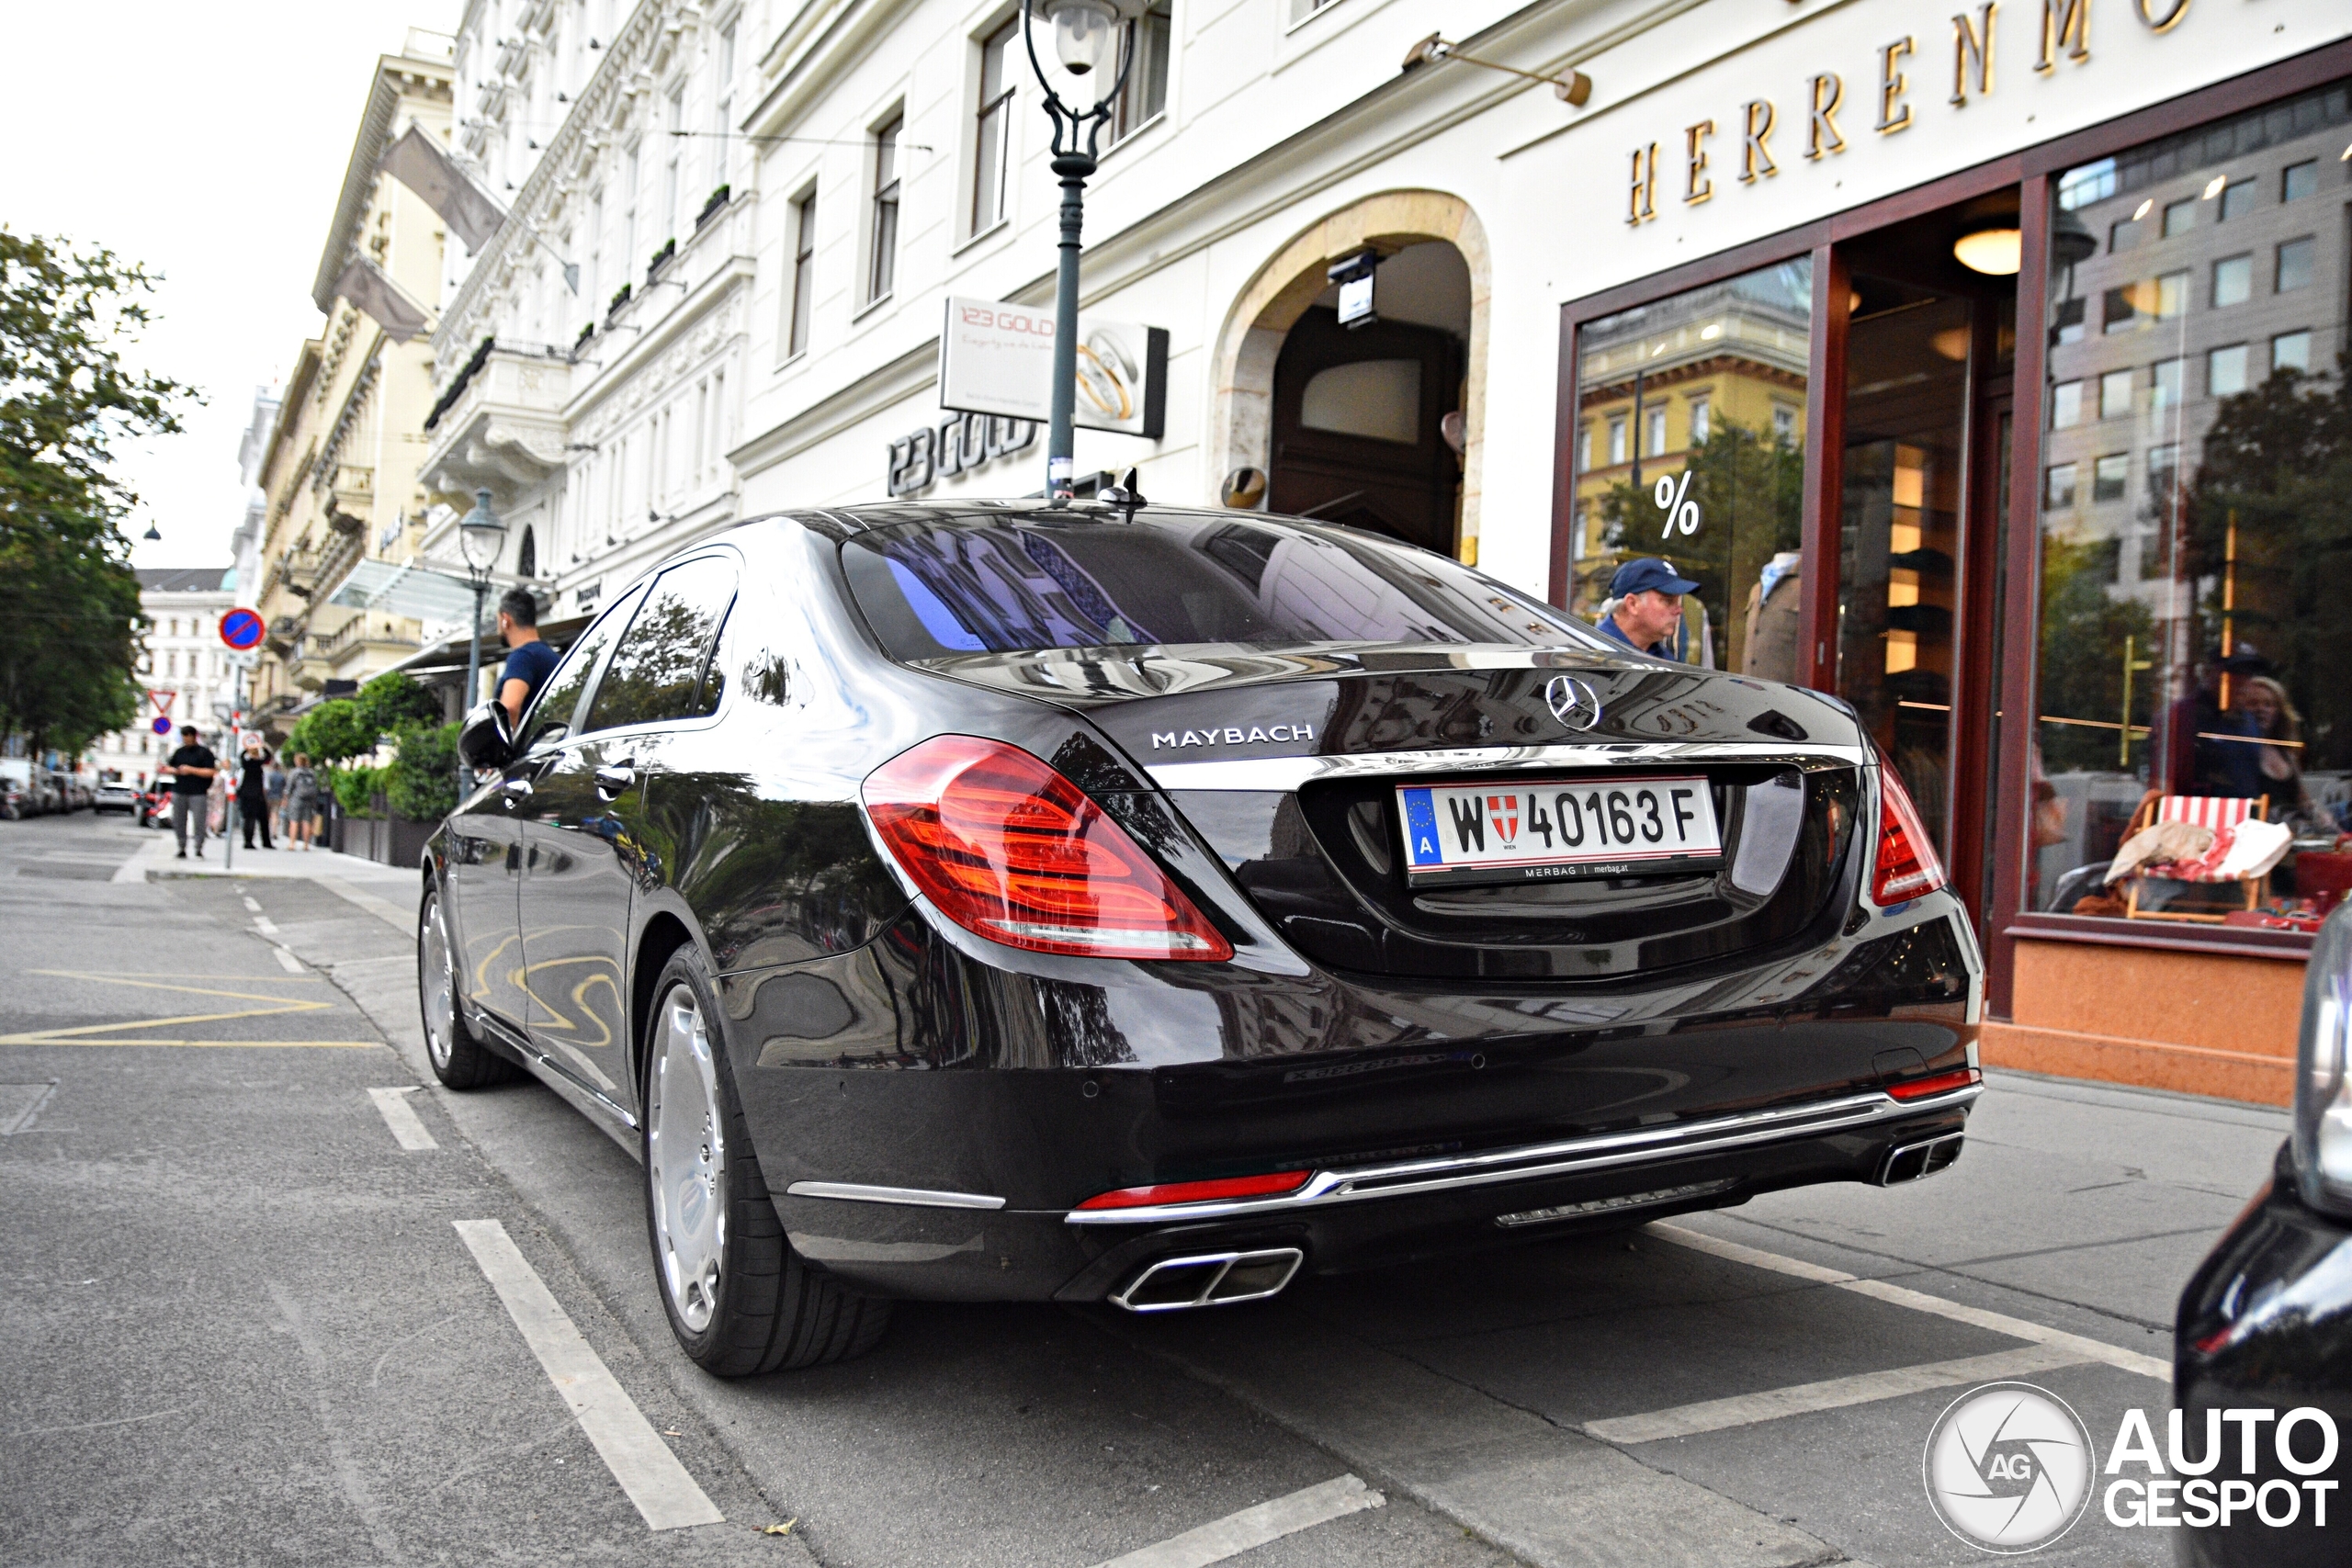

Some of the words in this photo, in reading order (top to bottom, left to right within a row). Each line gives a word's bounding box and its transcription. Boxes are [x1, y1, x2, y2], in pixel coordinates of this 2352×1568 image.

[961, 306, 994, 328] 123
[997, 312, 1056, 337] GOLD
[1151, 724, 1314, 750] MAYBACH
[1449, 795, 1485, 852] W
[1527, 790, 1664, 849] 40163
[1670, 789, 1693, 841] F
[1419, 837, 1433, 854] A
[1525, 866, 1577, 877] MERBAG
[1594, 864, 1629, 874] merbag.at
